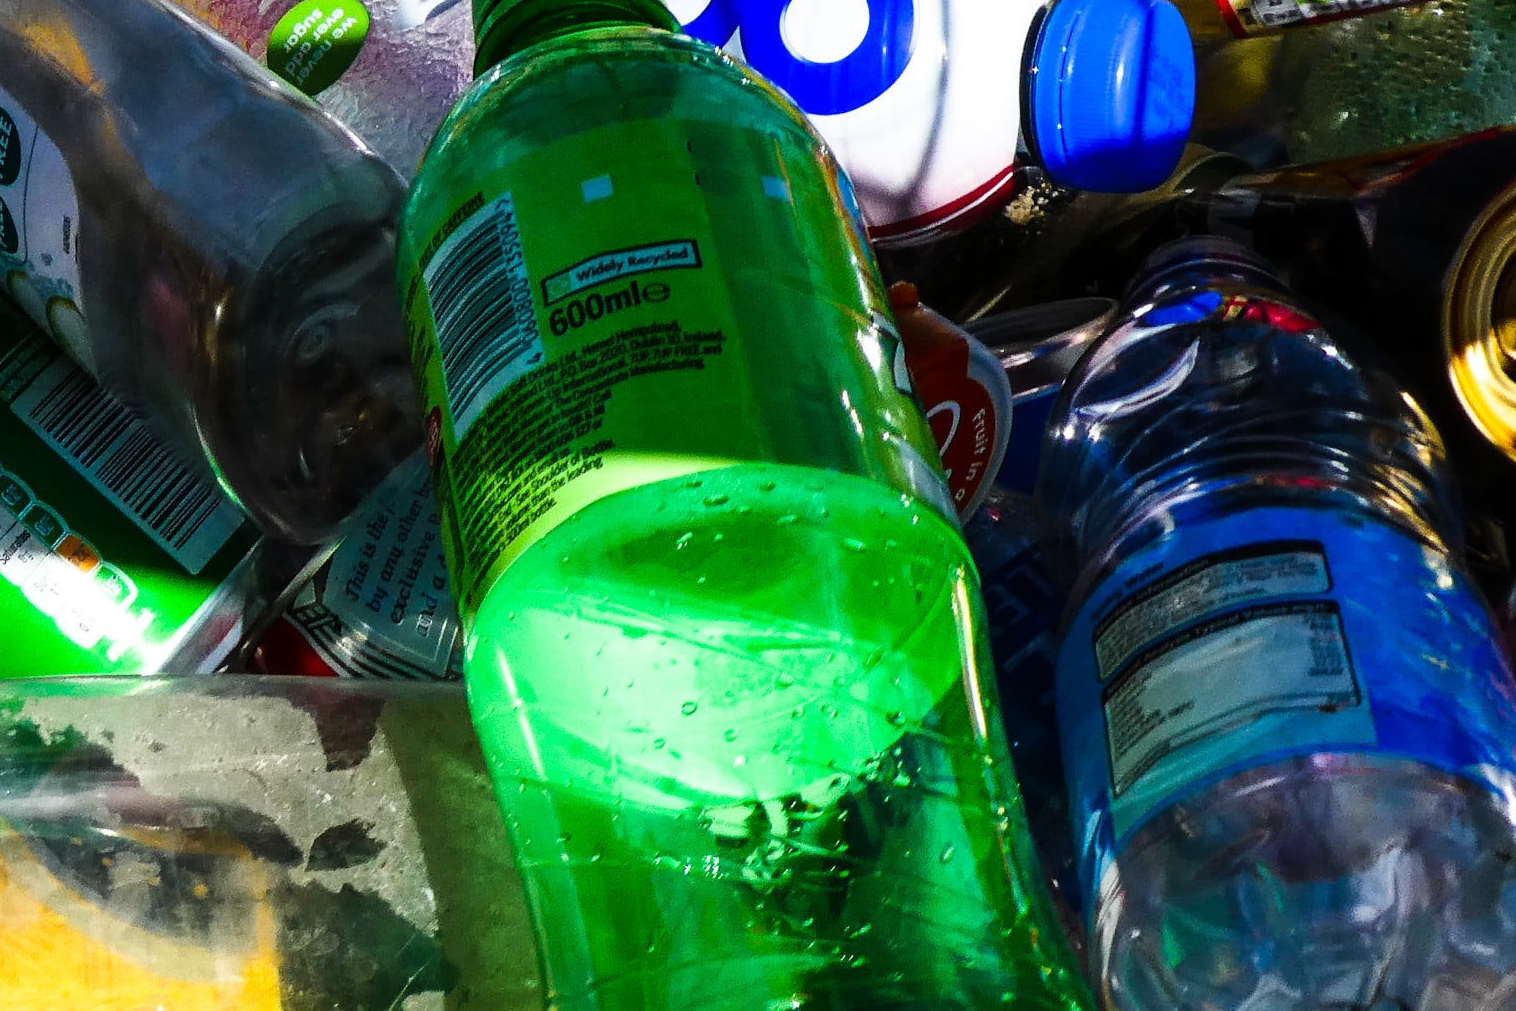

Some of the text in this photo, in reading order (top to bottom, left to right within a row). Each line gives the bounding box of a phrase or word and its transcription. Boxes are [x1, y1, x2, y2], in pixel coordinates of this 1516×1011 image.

[279, 3, 324, 57] sugar
[283, 2, 346, 76] ever add
[293, 11, 358, 88] we never
[575, 242, 689, 284] Widely Recycled
[544, 280, 645, 337] 600ml
[960, 405, 1001, 483] Fruit in
[340, 511, 389, 602] This is the
[365, 498, 425, 613] by any other
[378, 528, 444, 625] exclusive
[404, 573, 447, 638] and a
